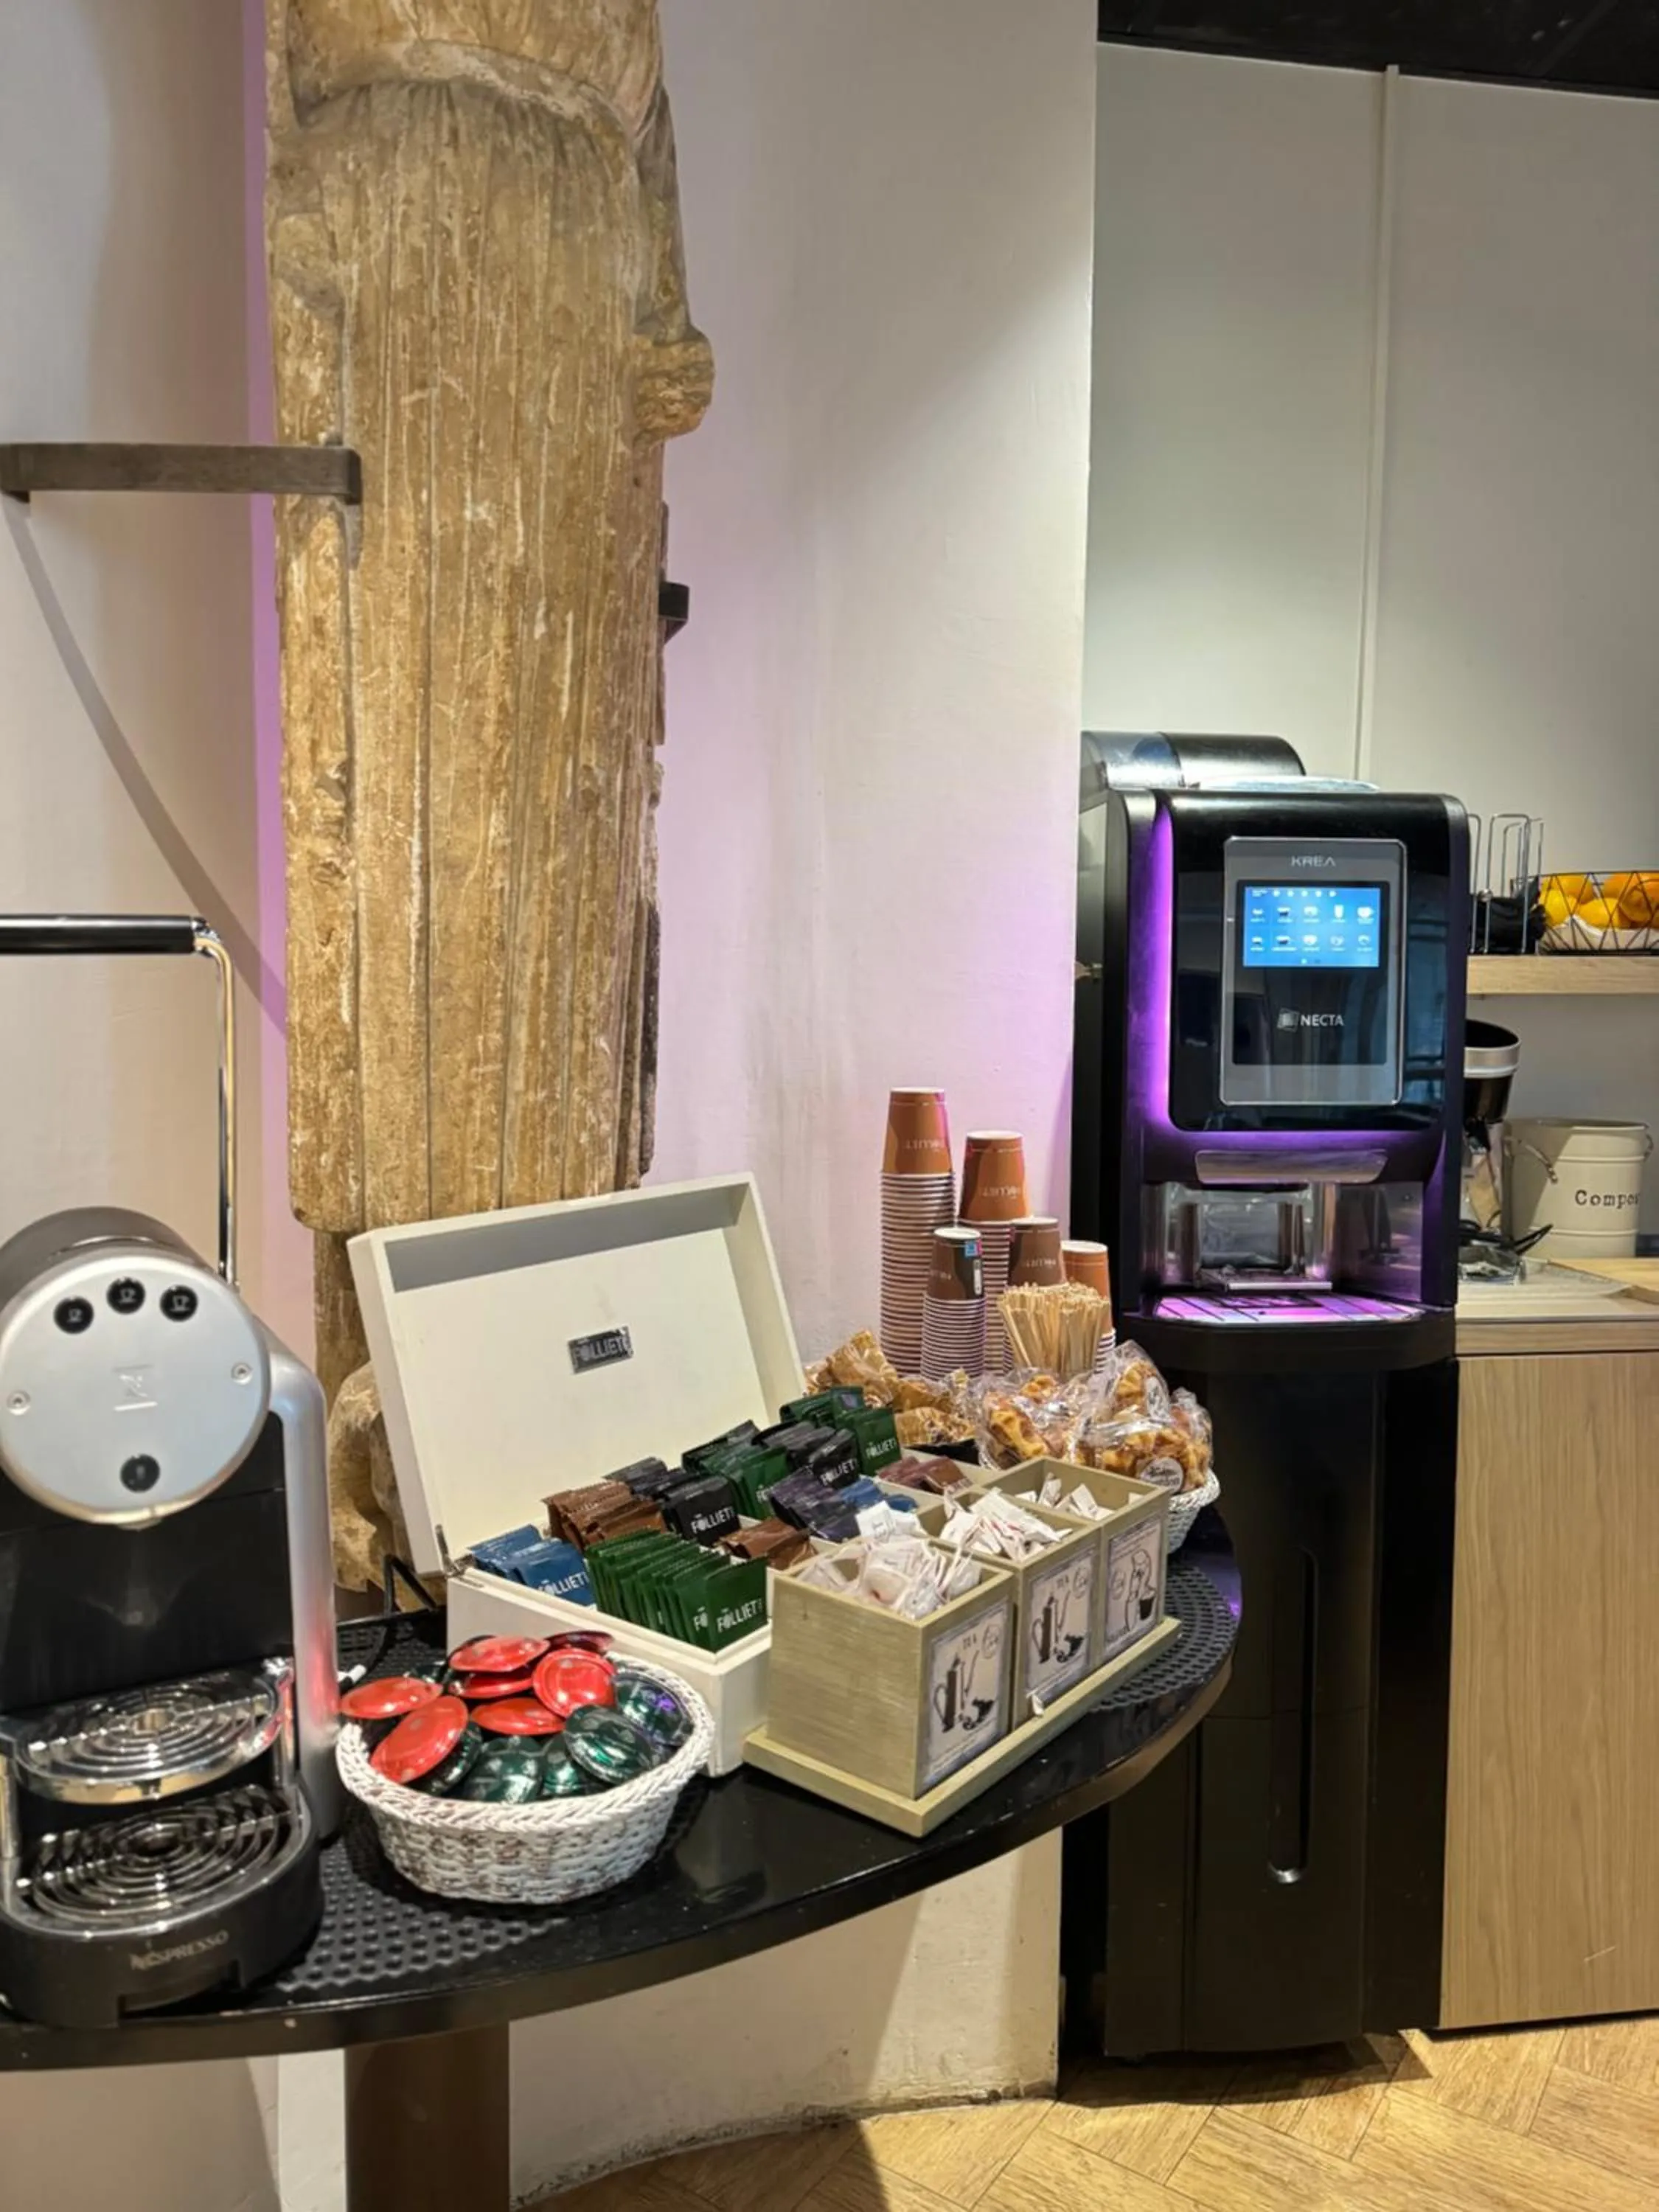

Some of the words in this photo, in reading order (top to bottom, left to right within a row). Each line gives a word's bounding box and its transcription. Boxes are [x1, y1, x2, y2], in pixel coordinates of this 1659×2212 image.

[1290, 855, 1337, 867] KREA
[1300, 1013, 1345, 1027] NECTA
[691, 1507, 732, 1534] FOLLIET
[717, 1600, 758, 1633] FOLLIET
